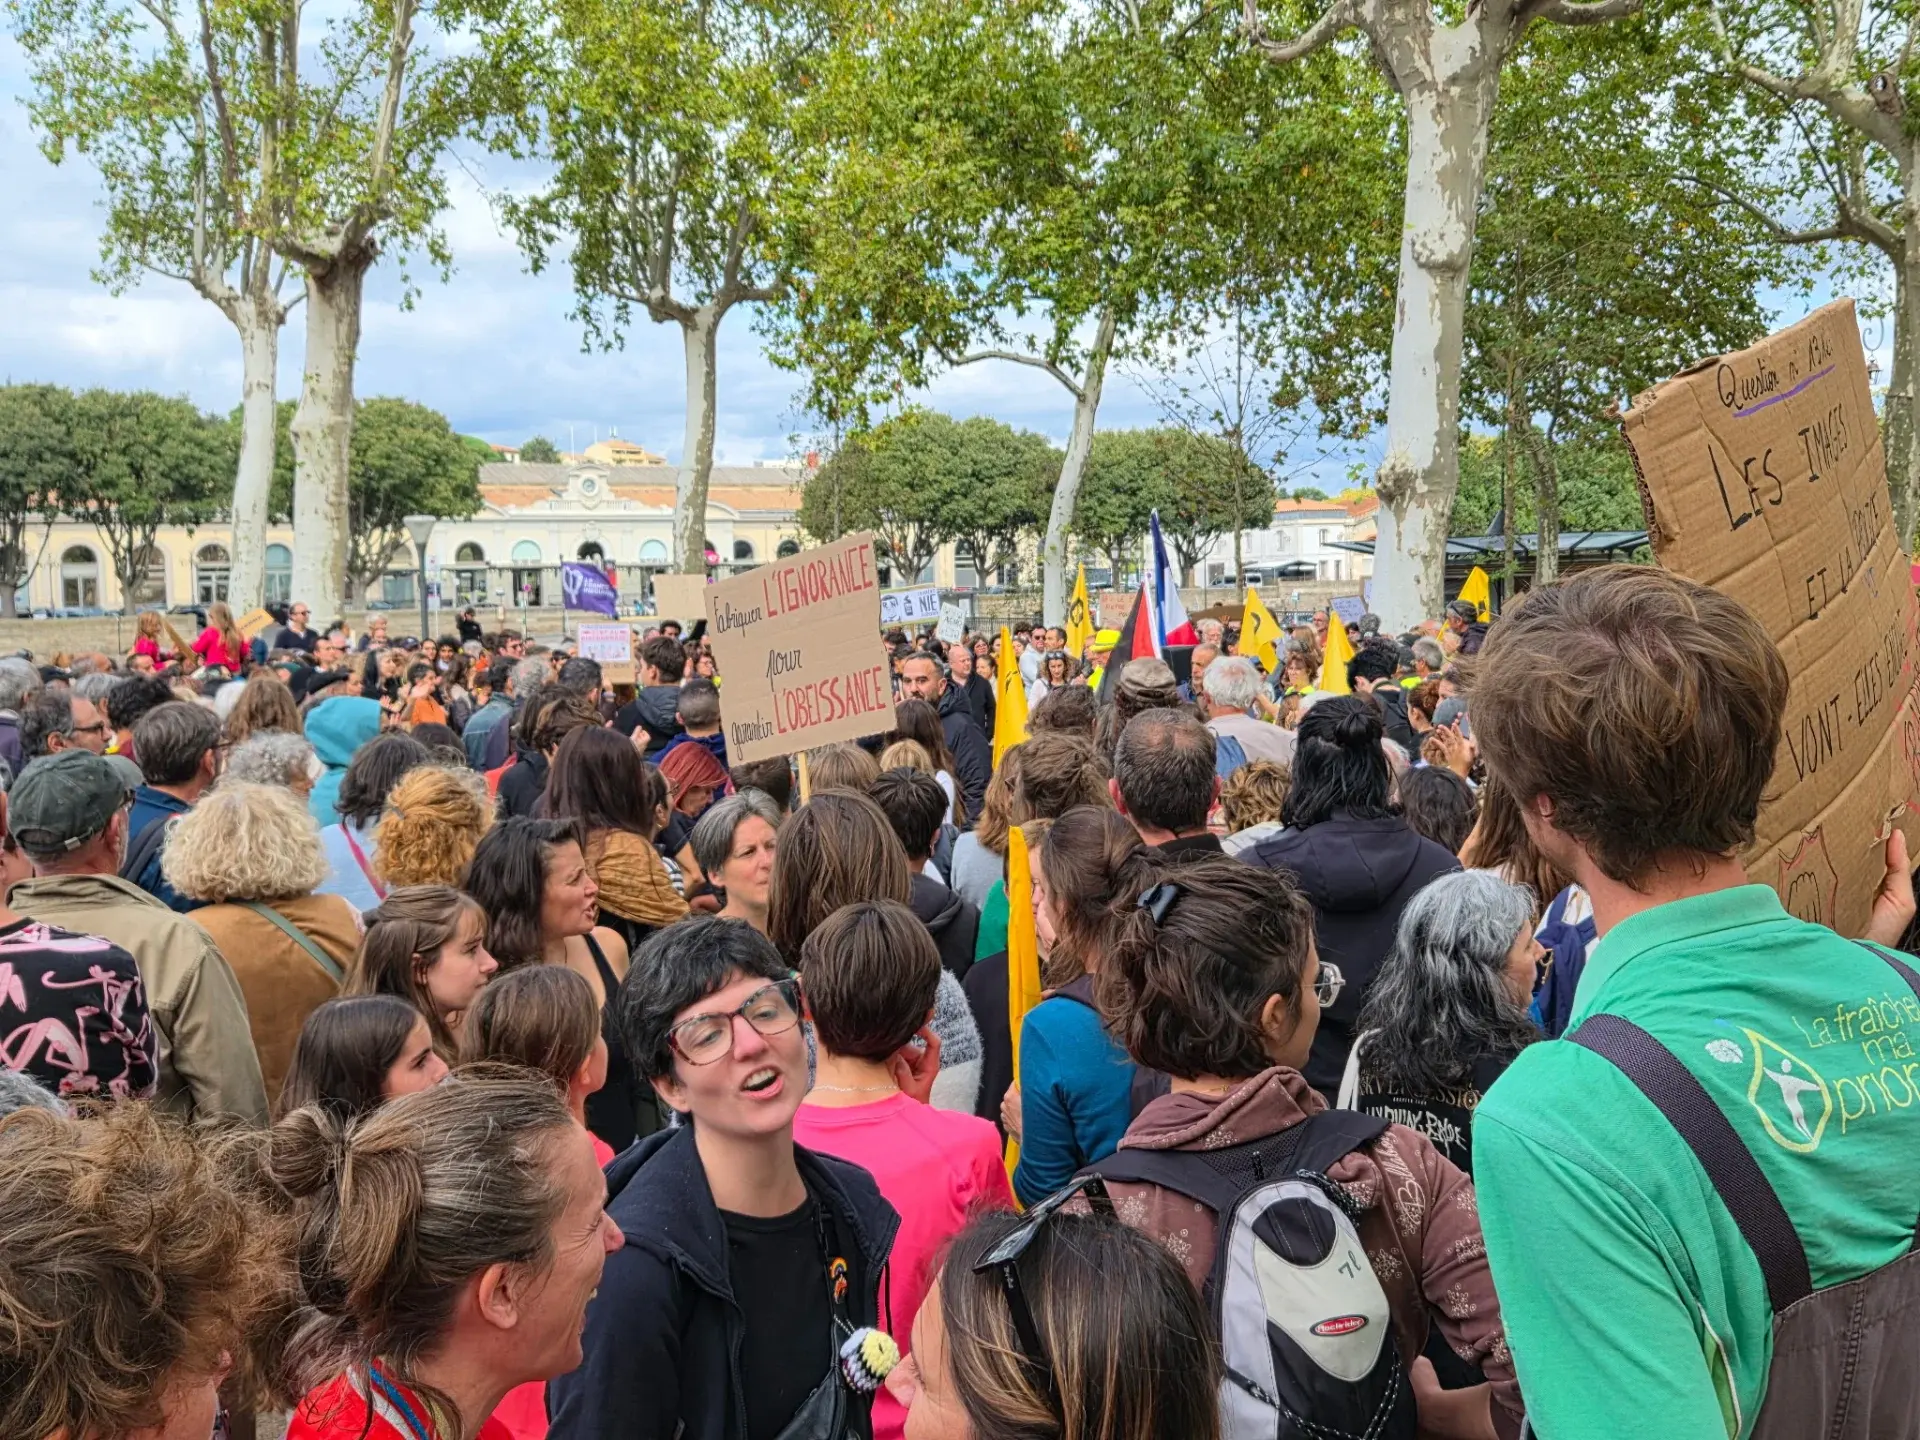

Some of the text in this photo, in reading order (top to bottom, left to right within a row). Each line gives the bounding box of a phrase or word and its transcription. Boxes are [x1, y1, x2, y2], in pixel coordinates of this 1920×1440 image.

[1717, 358, 1780, 410] Question
[1708, 444, 1782, 531] LES
[1798, 403, 1847, 483] IMAGES
[713, 543, 874, 638] Fabriquer L'IGNORANCE
[1806, 567, 1827, 620] ET
[766, 650, 802, 692] pour
[731, 666, 887, 761] garantir L'OBEISSANCE
[1792, 1015, 1836, 1048] La
[1862, 1032, 1916, 1065] ma
[1833, 1062, 1920, 1134] prior
